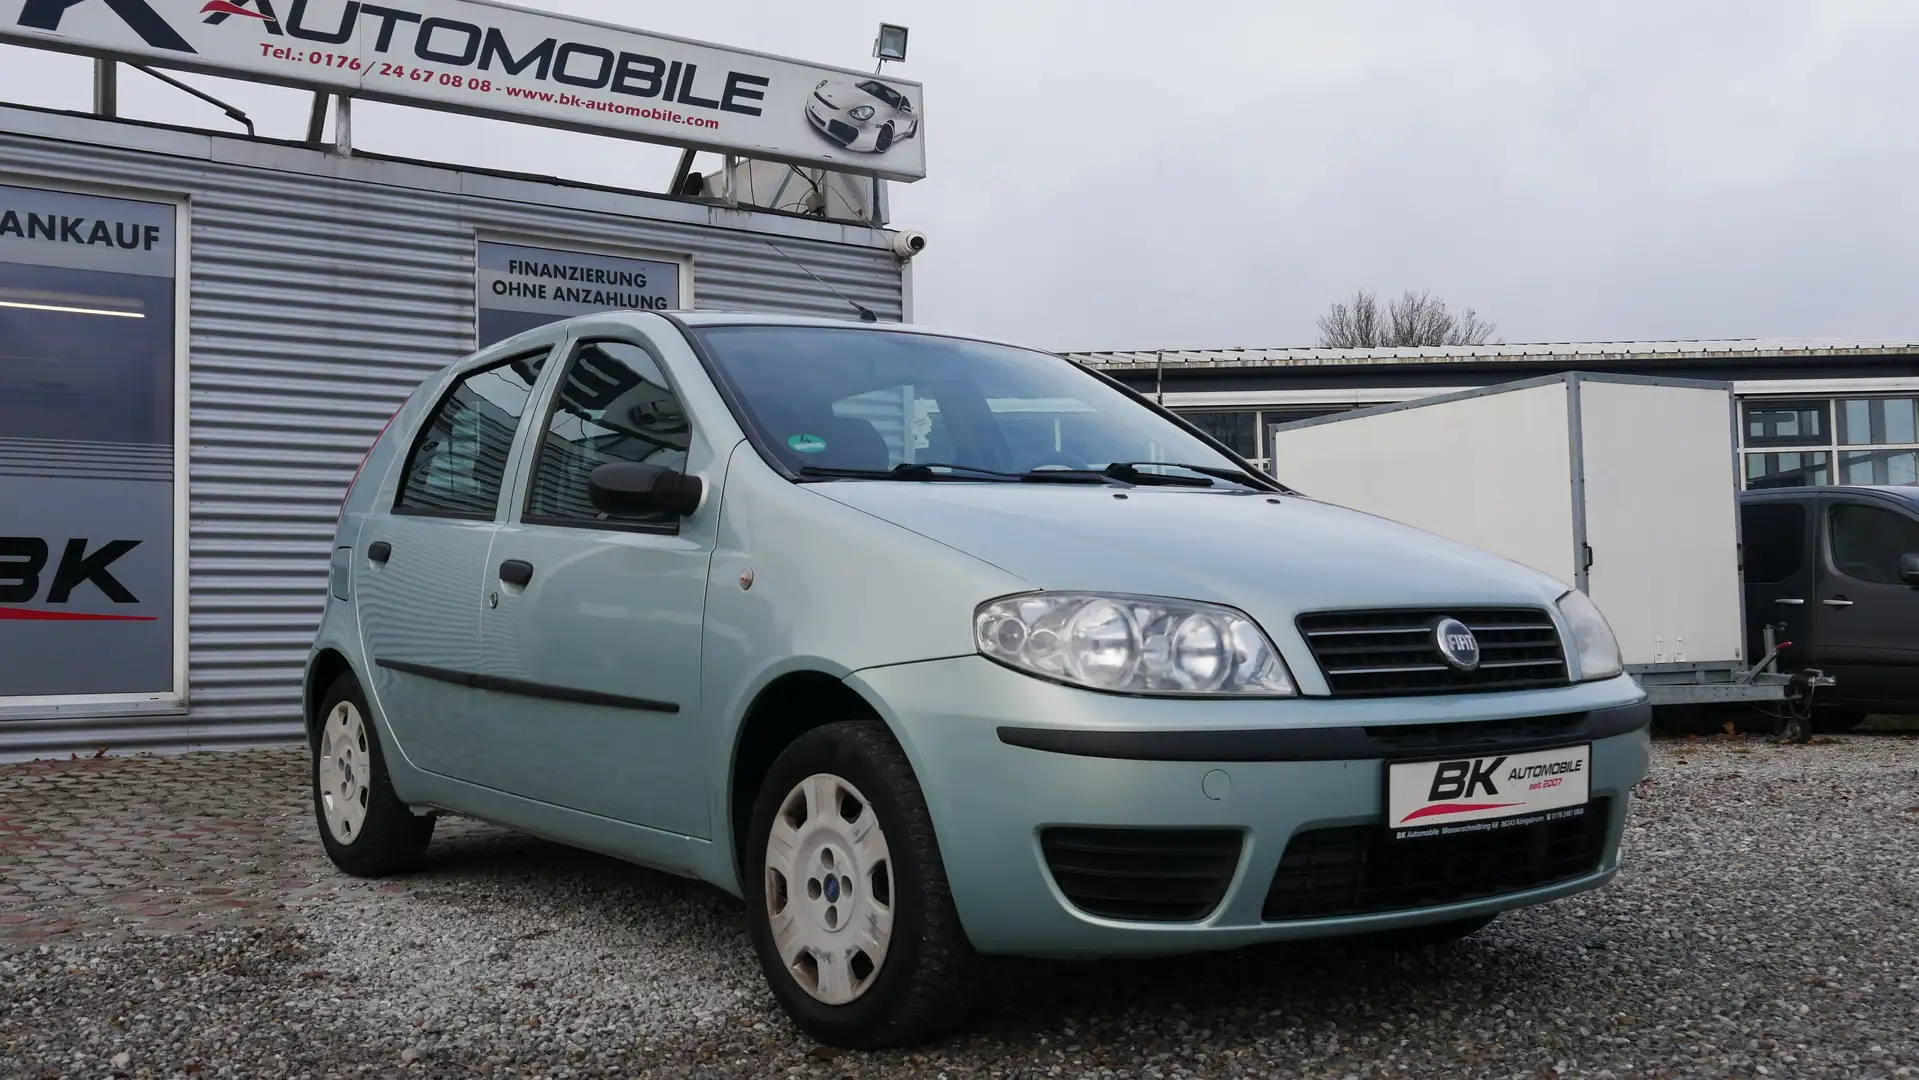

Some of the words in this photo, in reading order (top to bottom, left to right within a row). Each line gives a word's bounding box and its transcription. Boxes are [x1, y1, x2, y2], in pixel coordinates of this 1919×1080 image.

[201, 0, 770, 117] AUTOMOBILE
[260, 43, 303, 62] Tel.:
[309, 51, 361, 71] 0176
[379, 63, 404, 78] 24
[409, 68, 434, 83] 67
[439, 73, 463, 88] 08
[468, 78, 492, 93] 08
[506, 86, 719, 129] www.bk-automobile.com
[0, 210, 160, 251] ANKAUF
[509, 259, 647, 288] FINANZIERUNG
[492, 279, 546, 299] OHNE
[553, 286, 668, 310] ANZAHLUNG
[1446, 633, 1475, 651] FIAT
[1428, 757, 1508, 801] BK
[1508, 760, 1582, 780] AUTOMOBILE
[1543, 778, 1563, 788] 2007
[1407, 828, 1440, 838] Automobile
